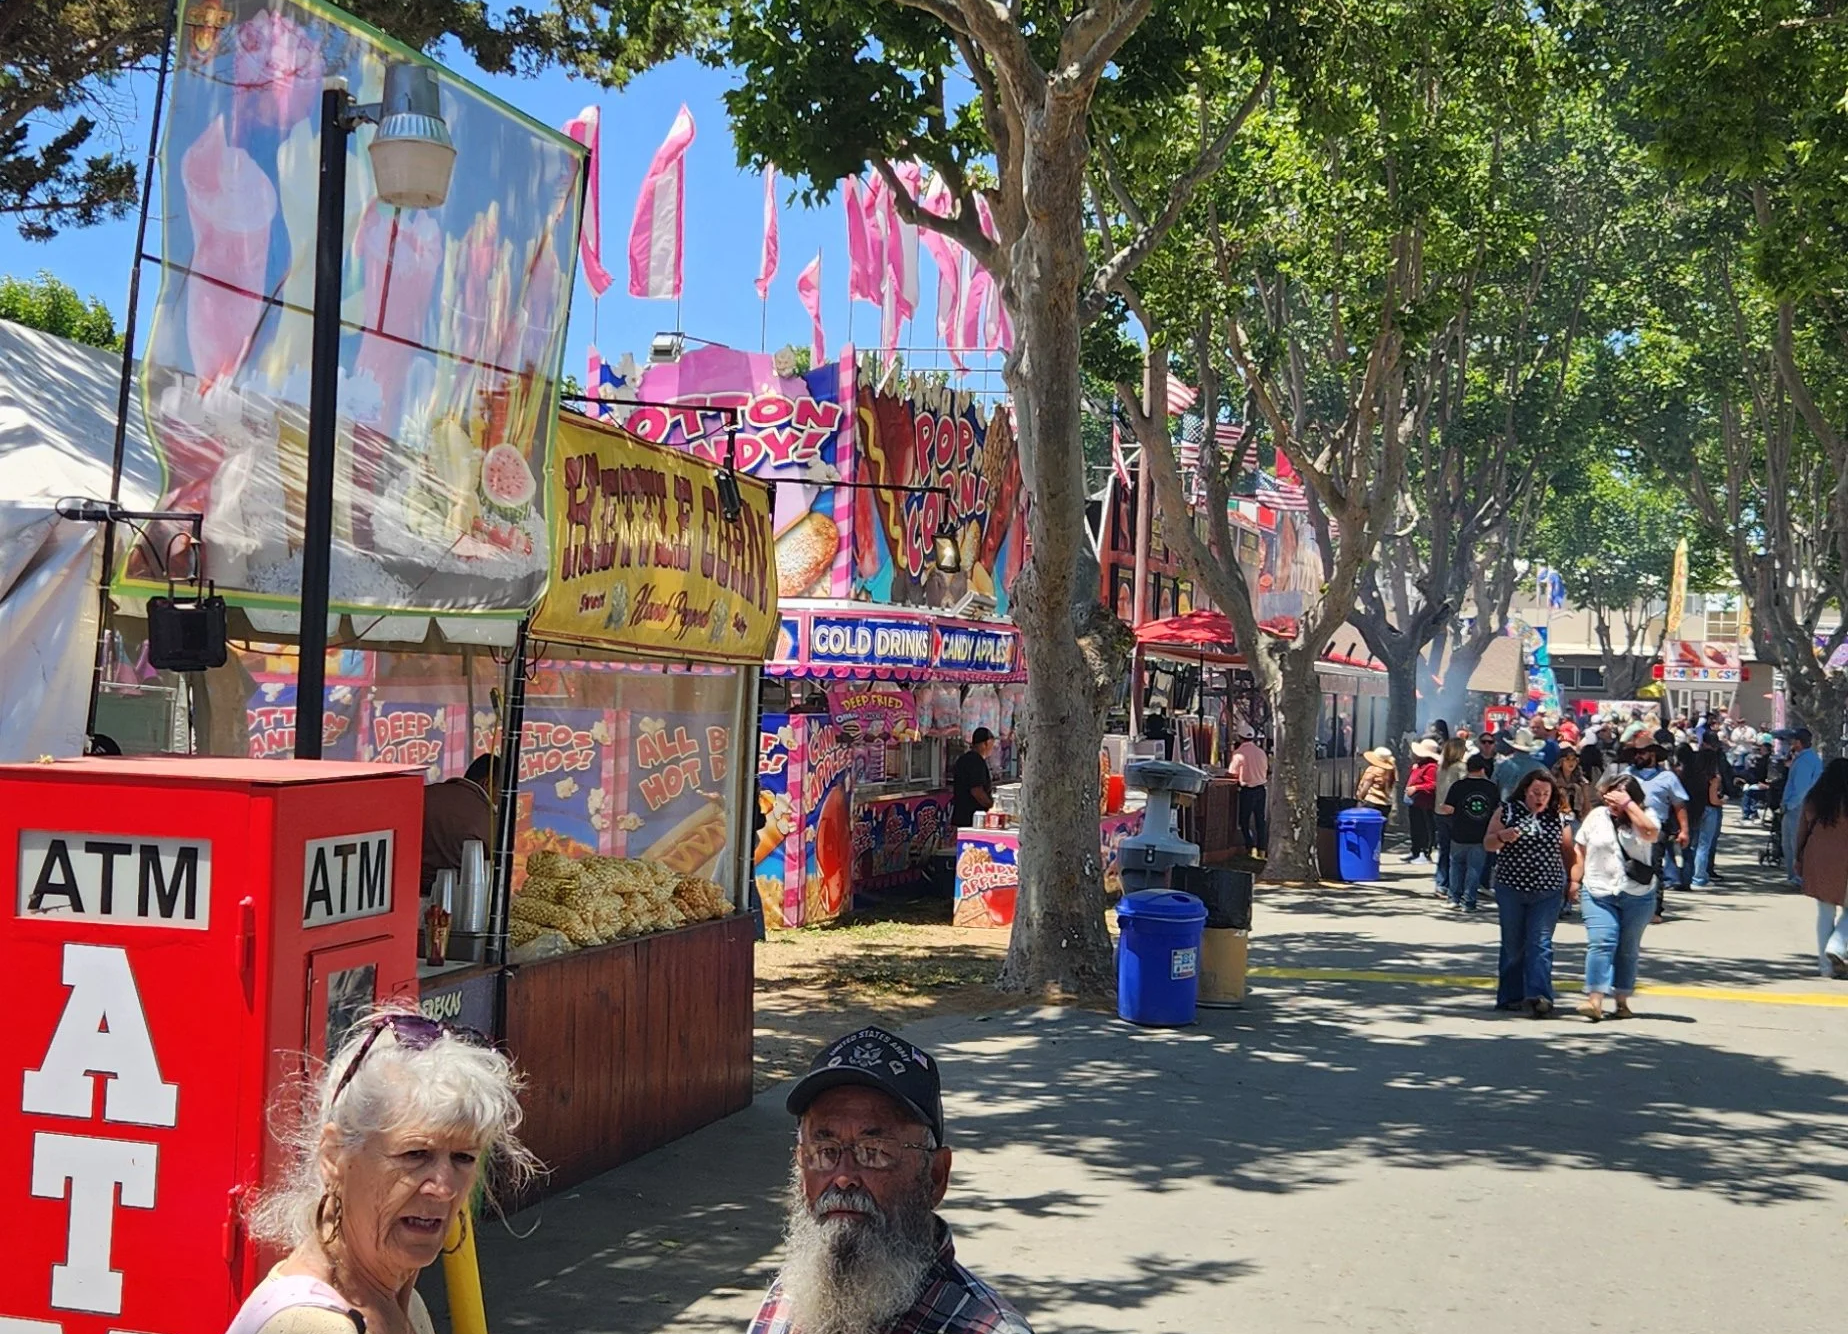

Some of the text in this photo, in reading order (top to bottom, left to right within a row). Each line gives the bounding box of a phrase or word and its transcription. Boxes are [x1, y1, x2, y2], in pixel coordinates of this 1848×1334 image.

[622, 392, 843, 446] OTTON
[690, 428, 830, 471] NDY!
[915, 412, 974, 484] POP
[561, 452, 693, 581] KETTLE
[906, 470, 989, 577] CORN!
[813, 625, 929, 658] COLD DRINKS
[941, 637, 1008, 664] CANDY APPLES
[841, 695, 903, 711] DEEP FRIED
[373, 712, 432, 751] DEEP
[374, 740, 442, 765] RIED!
[637, 726, 700, 769] ALL
[639, 757, 701, 812] HOT
[27, 838, 199, 921] ATM
[303, 838, 387, 921] ATM
[828, 1029, 912, 1062] UNITED STATES ARMY
